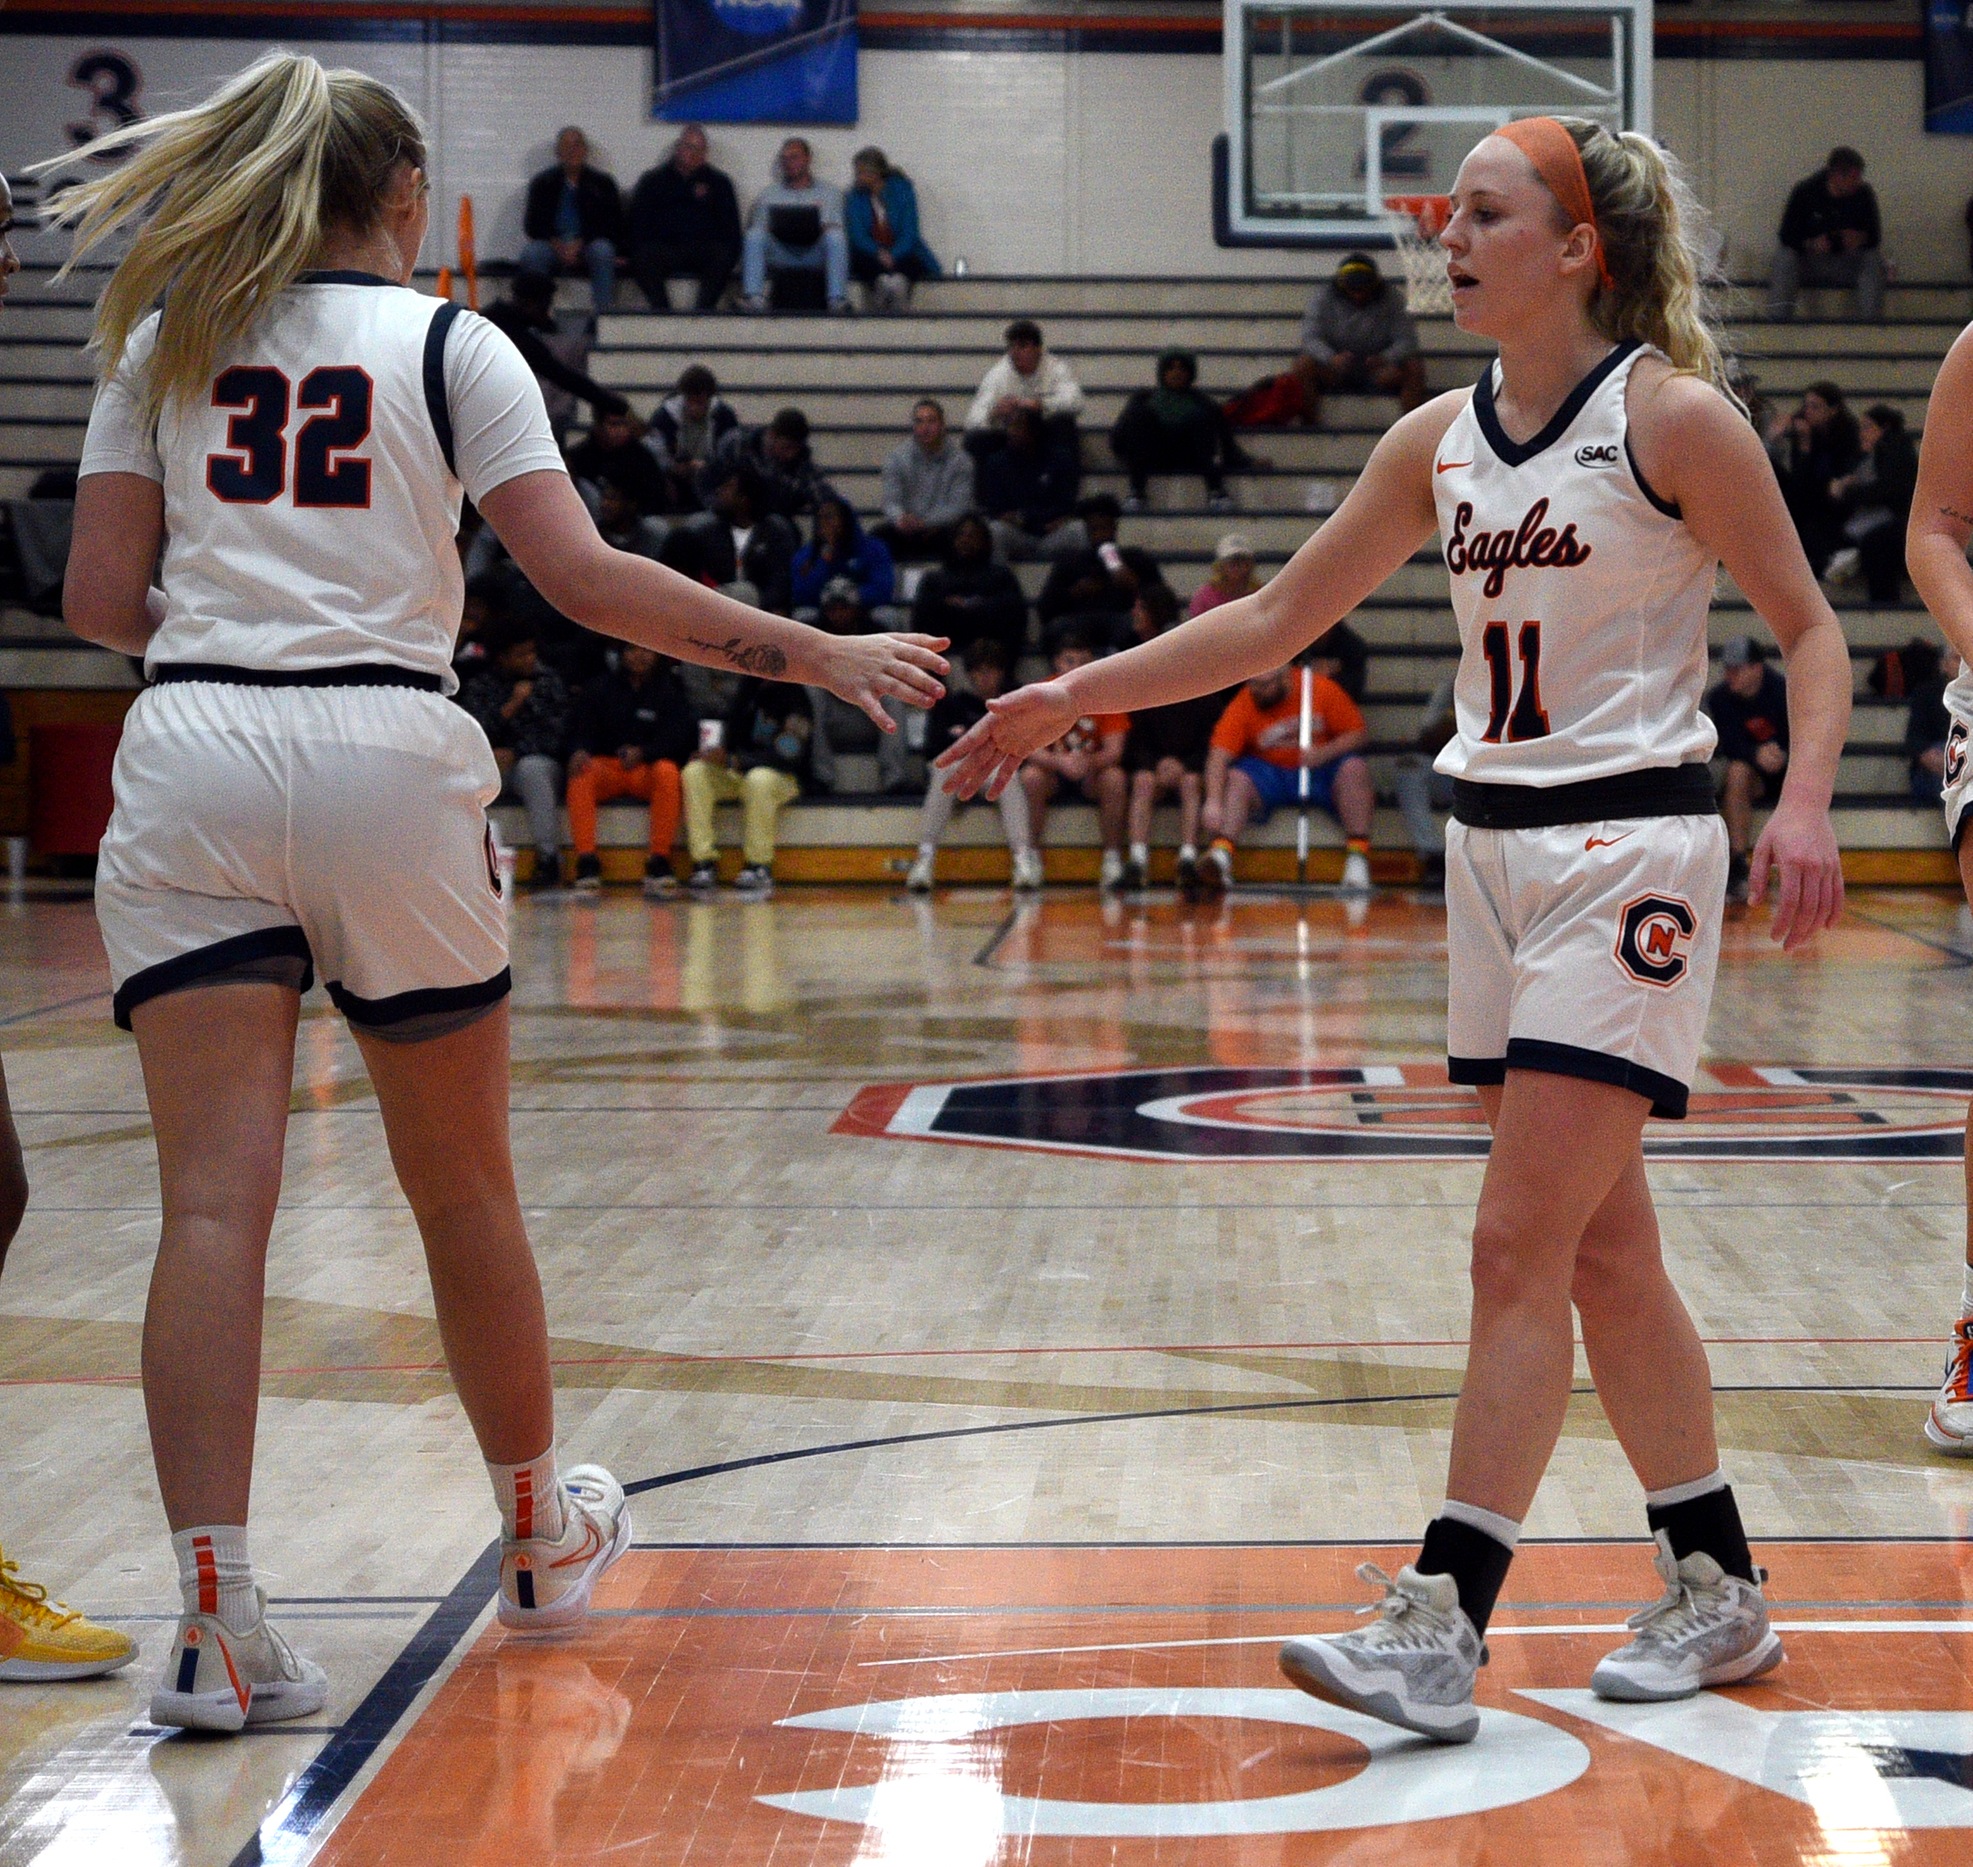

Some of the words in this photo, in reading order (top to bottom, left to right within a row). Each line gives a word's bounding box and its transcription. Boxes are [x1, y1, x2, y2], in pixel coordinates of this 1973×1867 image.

[64, 46, 146, 167] 3
[1351, 63, 1433, 181] 2
[206, 364, 375, 510] 32
[1580, 443, 1619, 462] SAC
[1447, 496, 1593, 599] Eagles
[1479, 620, 1551, 744] 11
